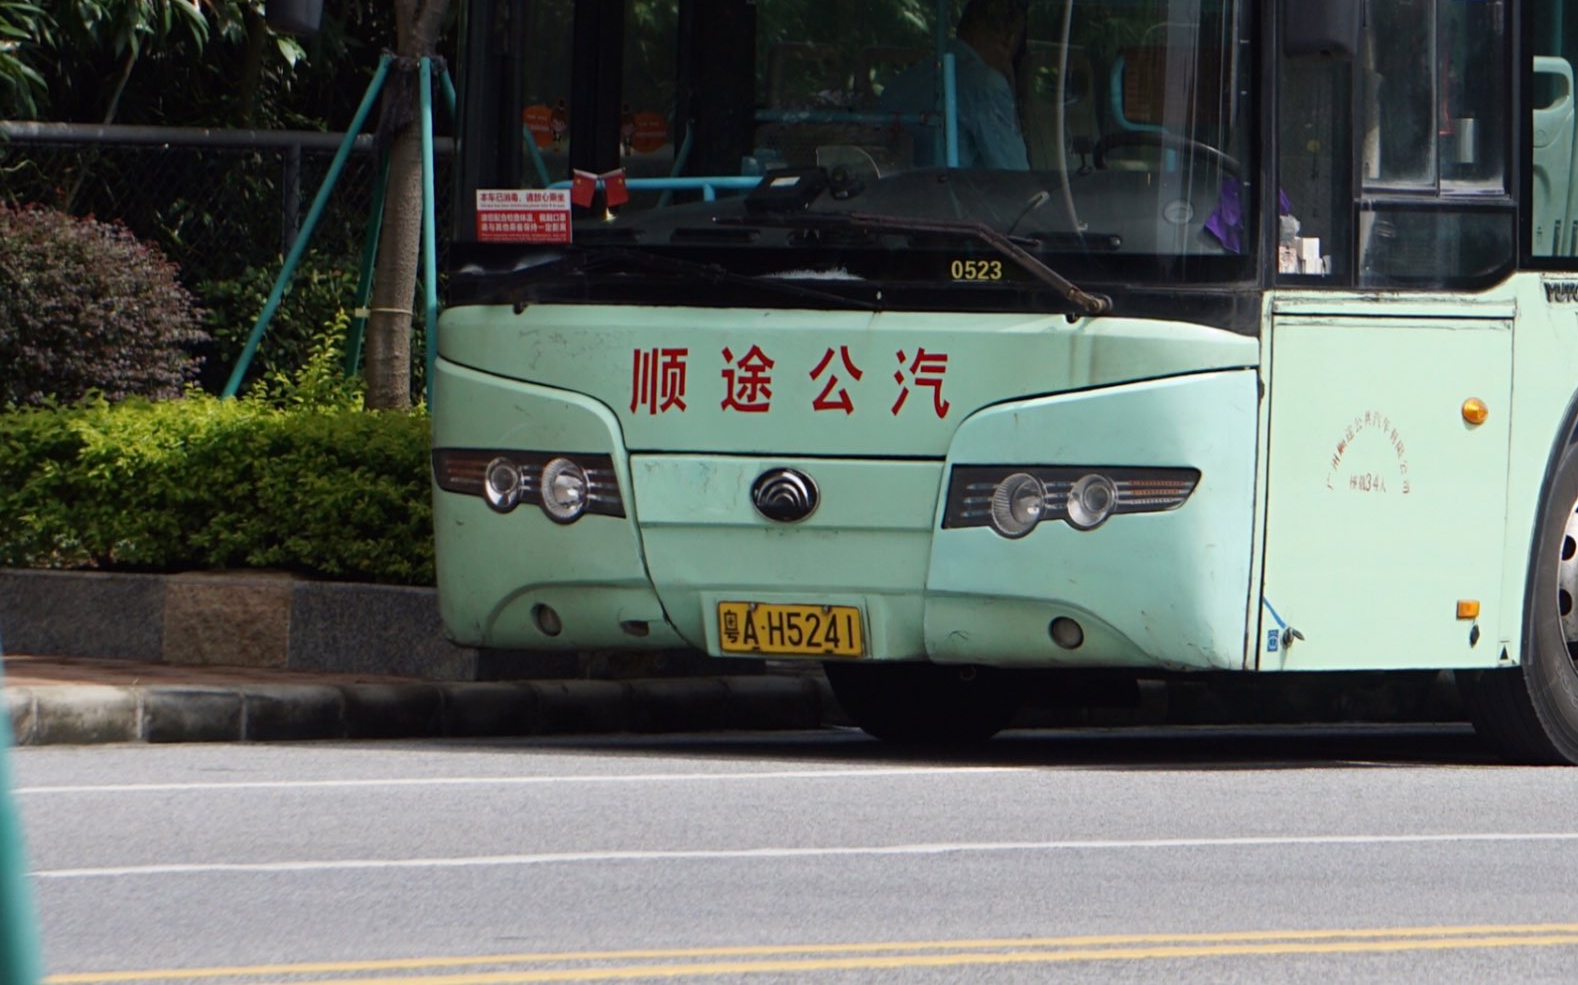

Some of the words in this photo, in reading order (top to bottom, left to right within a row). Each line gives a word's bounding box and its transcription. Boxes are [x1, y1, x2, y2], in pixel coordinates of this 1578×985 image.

[951, 260, 1002, 279] 0523
[630, 344, 950, 419] 顺途公汽
